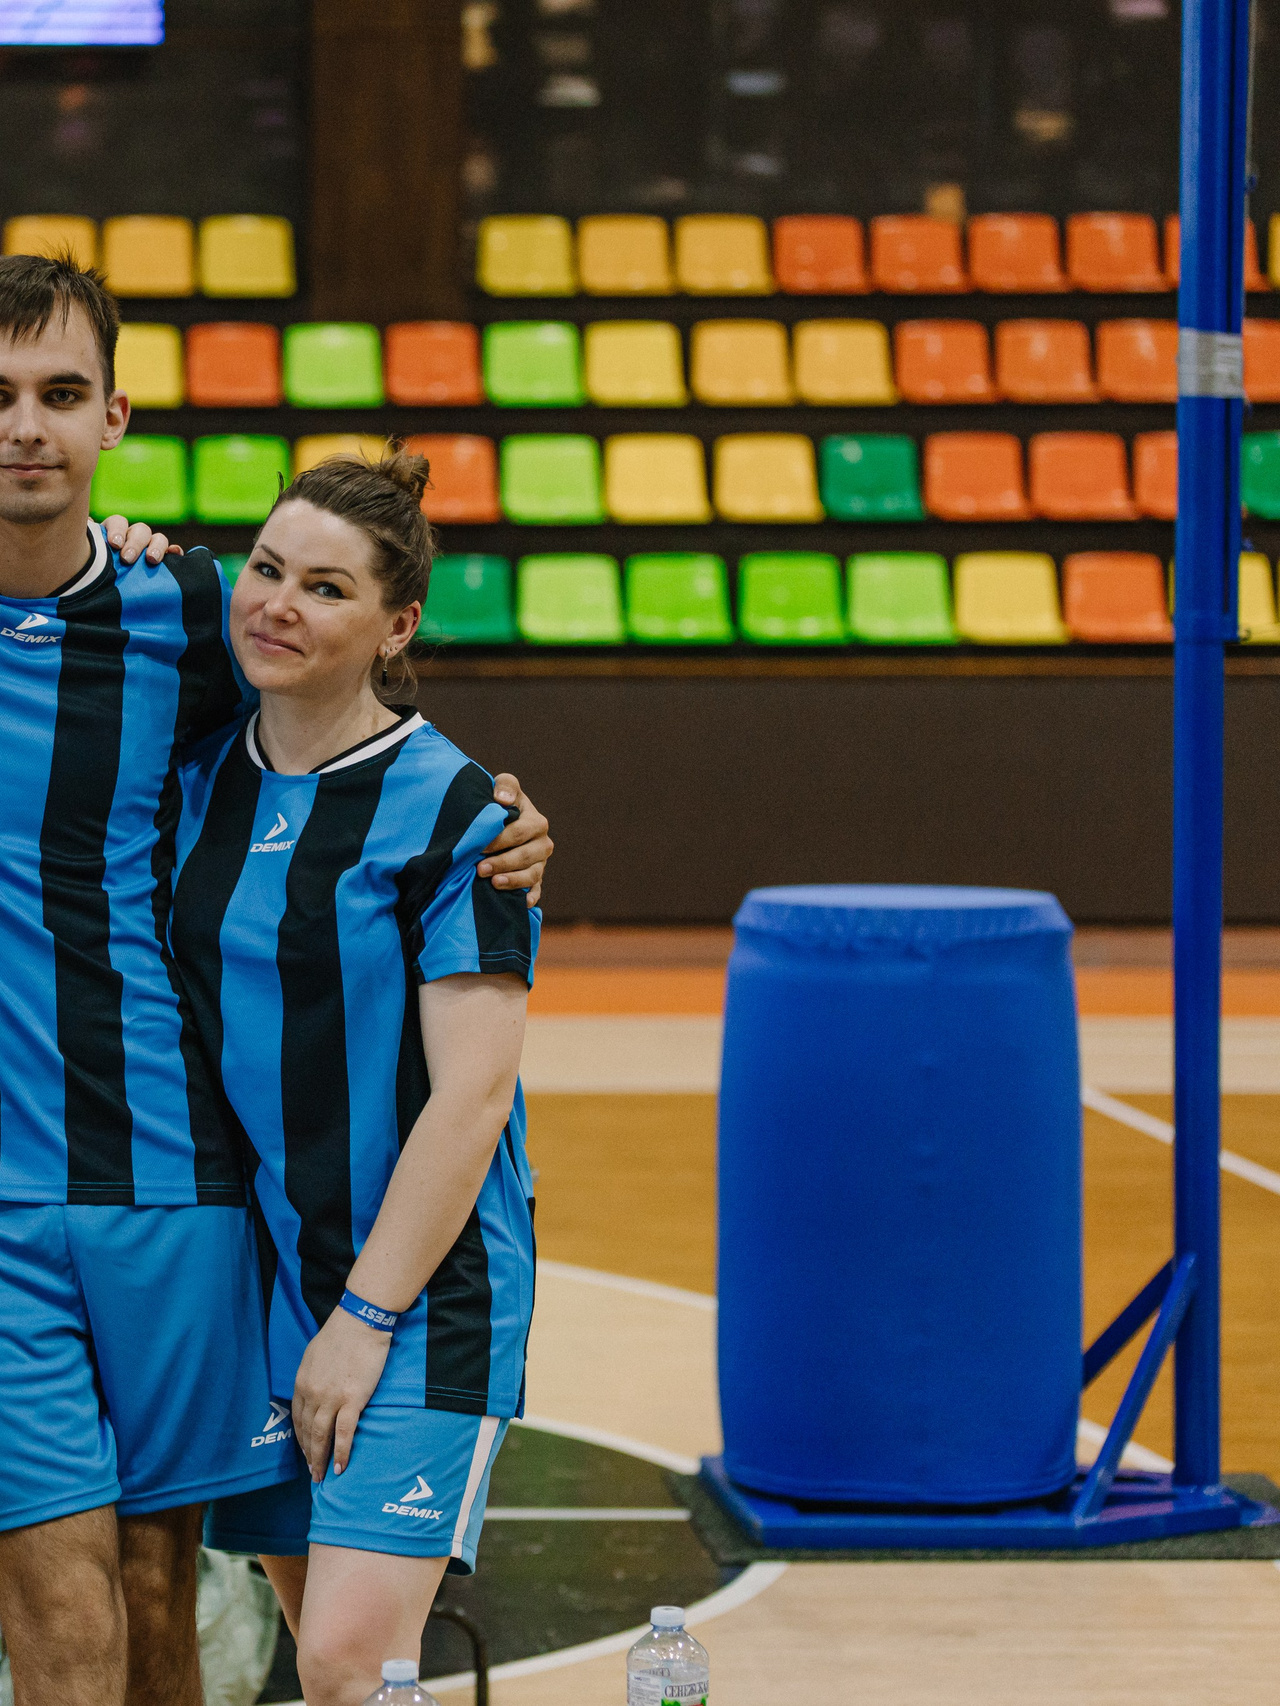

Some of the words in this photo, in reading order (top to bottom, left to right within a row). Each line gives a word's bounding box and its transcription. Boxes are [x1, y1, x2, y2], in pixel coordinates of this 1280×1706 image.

[0, 627, 61, 643] DEMIX
[250, 840, 295, 852] DEMIX
[251, 1428, 292, 1448] DEM
[381, 1502, 443, 1520] DEMIX
